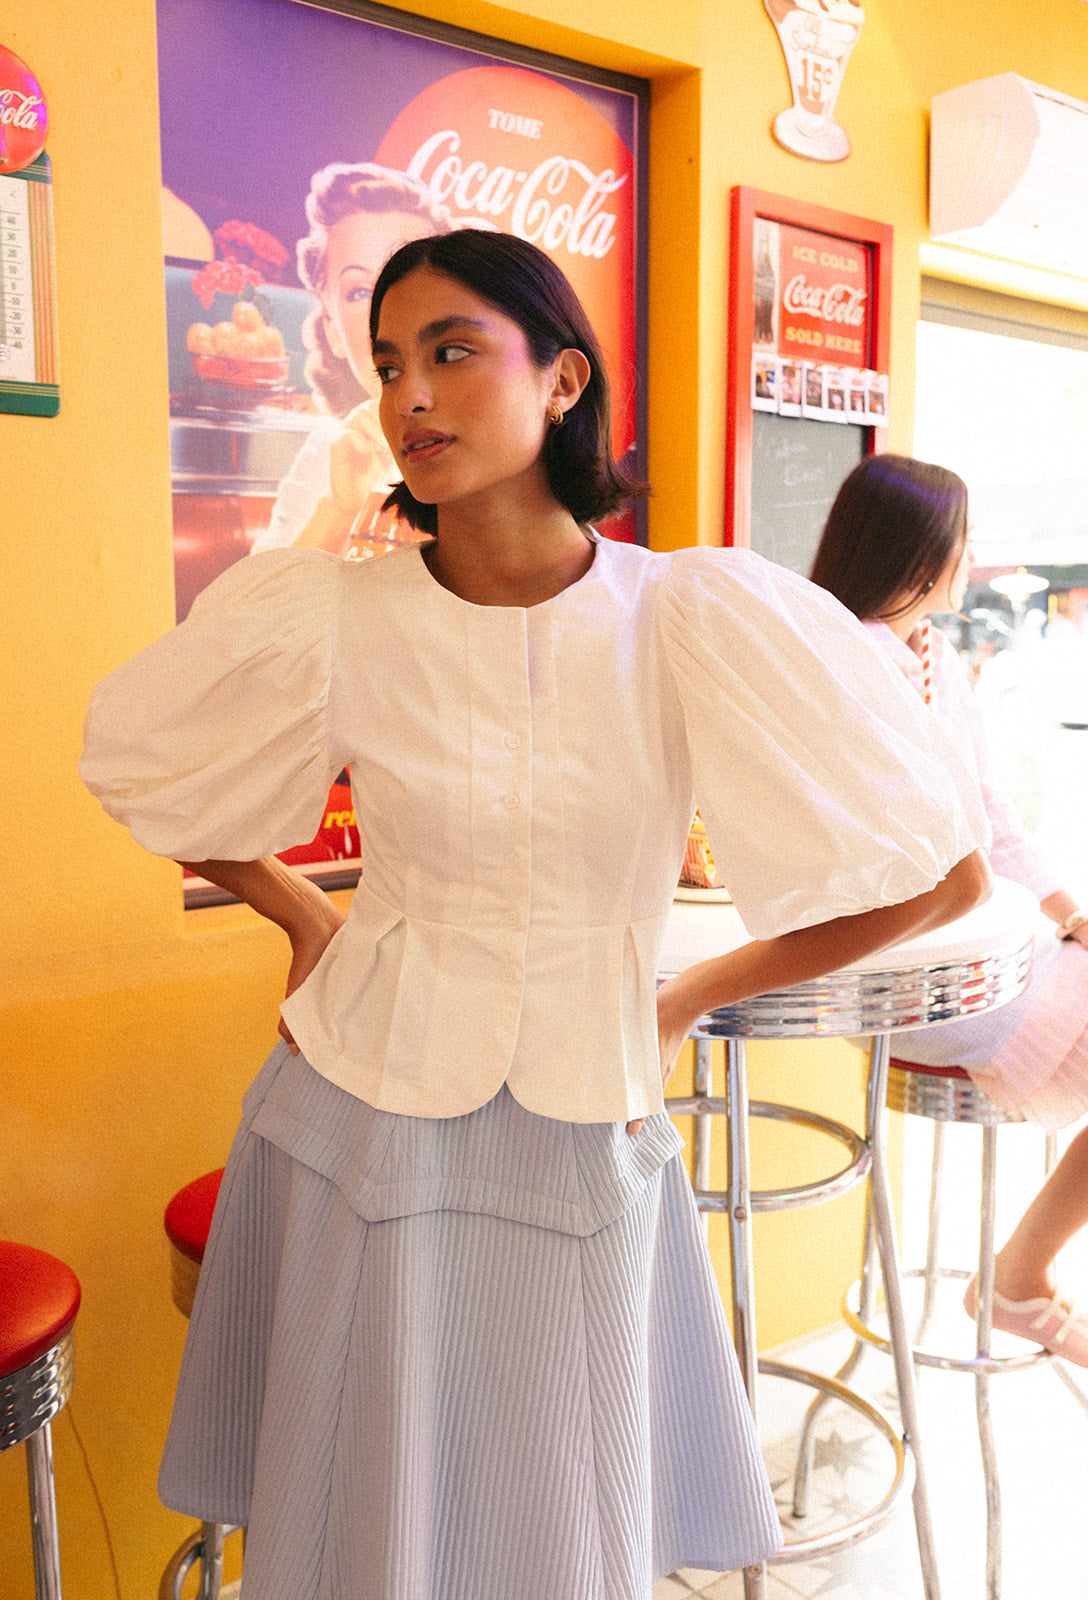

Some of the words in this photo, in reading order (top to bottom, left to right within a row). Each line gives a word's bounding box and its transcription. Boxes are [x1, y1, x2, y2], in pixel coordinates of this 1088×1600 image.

[487, 108, 544, 140] TOME
[793, 245, 817, 265] ICE
[819, 251, 859, 273] COLD
[785, 326, 824, 347] SOLD
[825, 333, 863, 354] HERE
